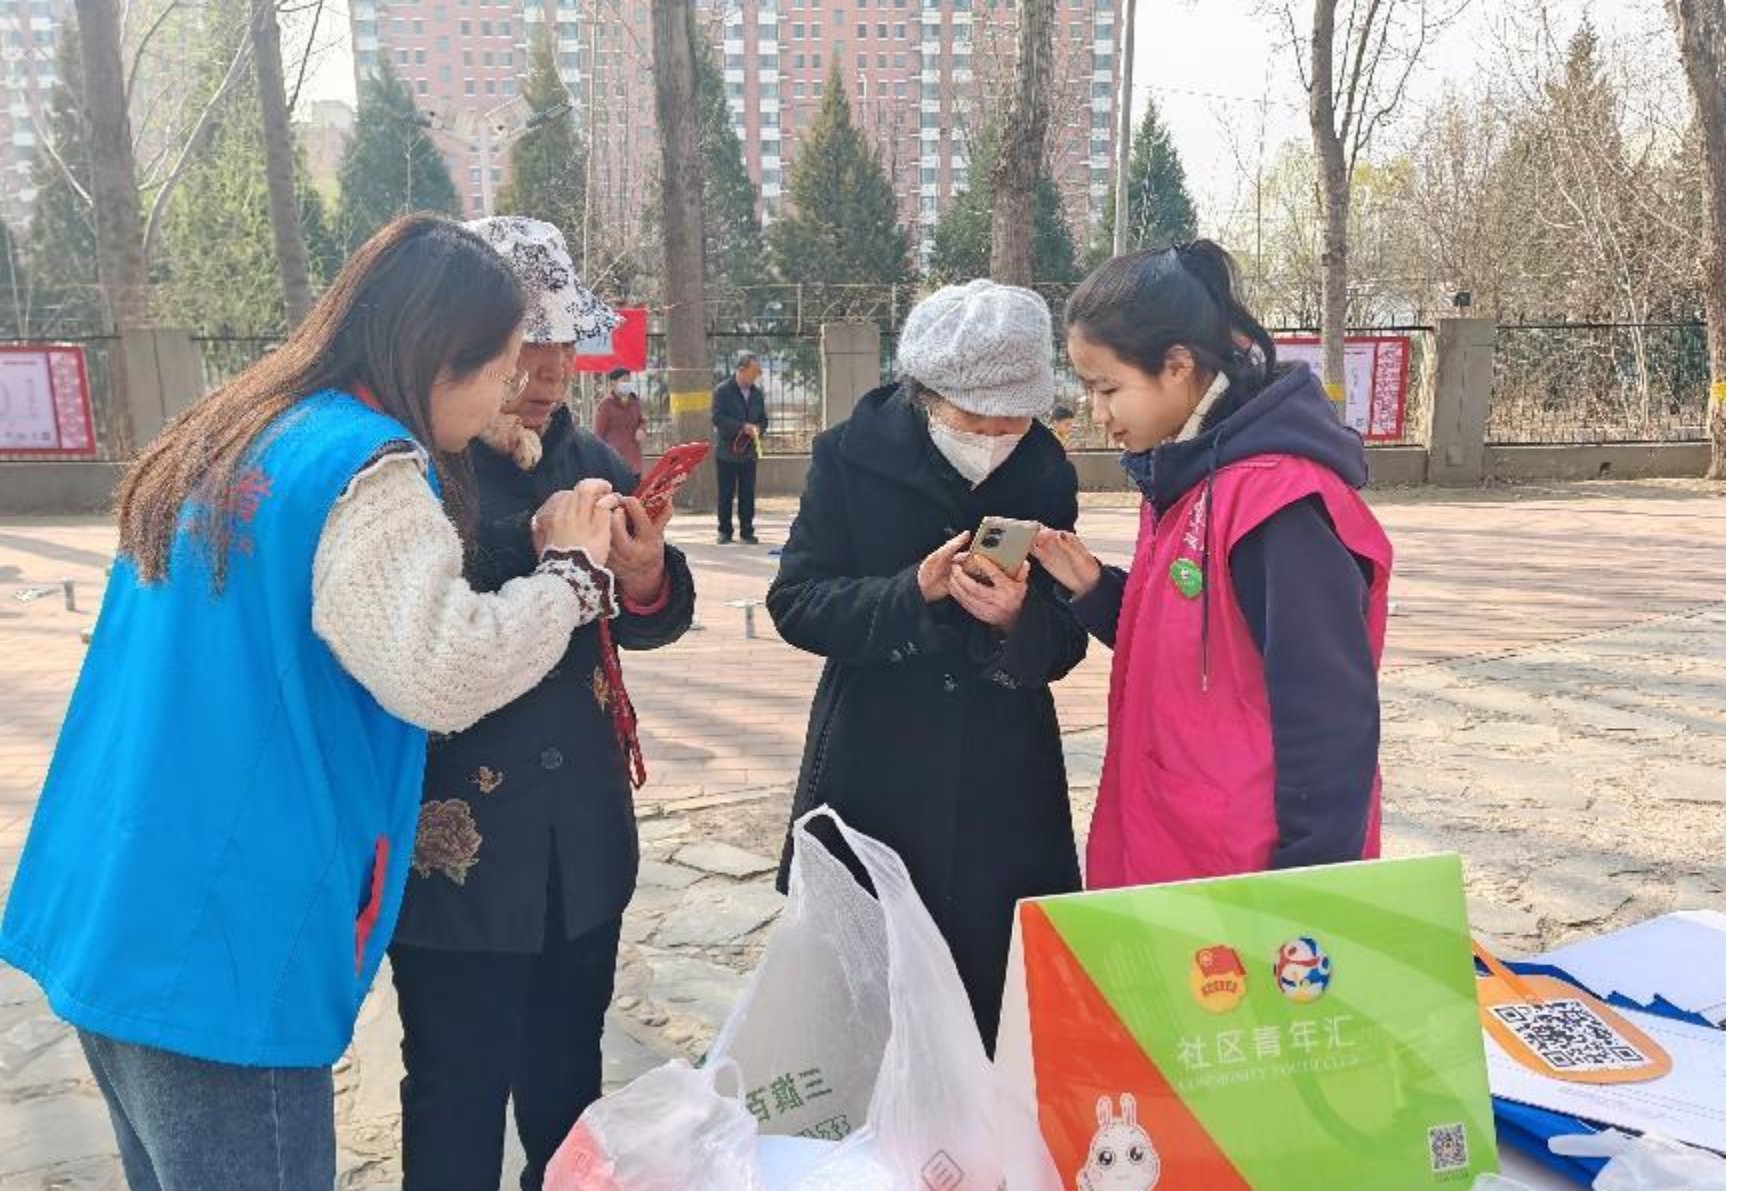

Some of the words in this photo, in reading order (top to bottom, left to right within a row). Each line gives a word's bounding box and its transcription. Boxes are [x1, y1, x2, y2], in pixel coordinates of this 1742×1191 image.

[1178, 1016, 1354, 1070] 社区青年汇
